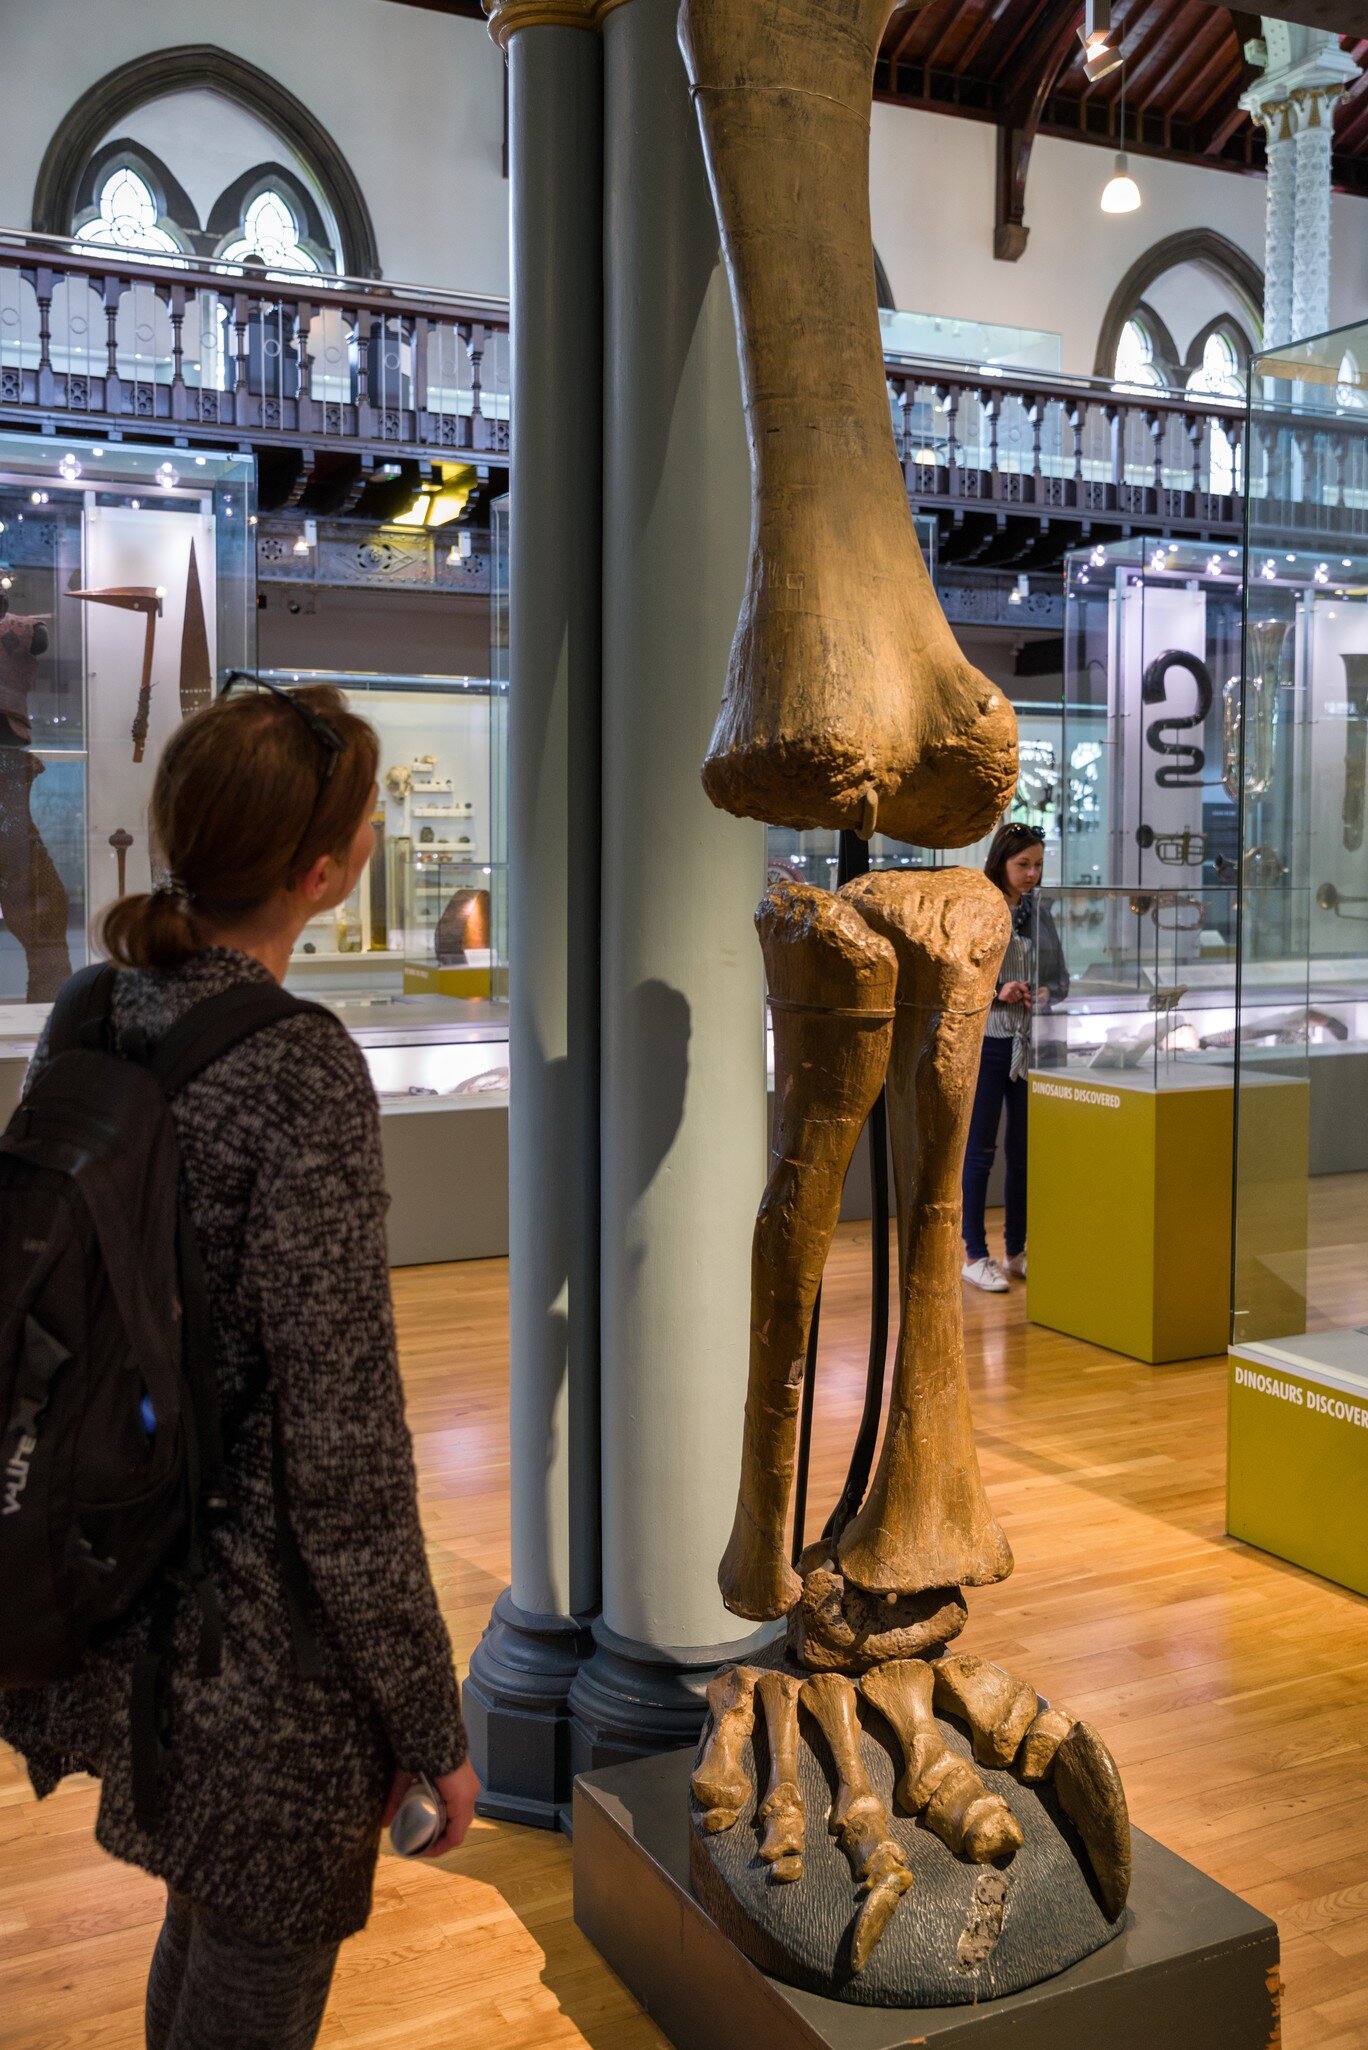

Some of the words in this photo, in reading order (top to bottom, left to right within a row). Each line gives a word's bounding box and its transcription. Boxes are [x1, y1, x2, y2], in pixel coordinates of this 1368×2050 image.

[1032, 1081, 1072, 1100] DINOSAURS
[1074, 1089, 1120, 1108] DISCOVERED
[1235, 1366, 1303, 1406] DINOSAURS
